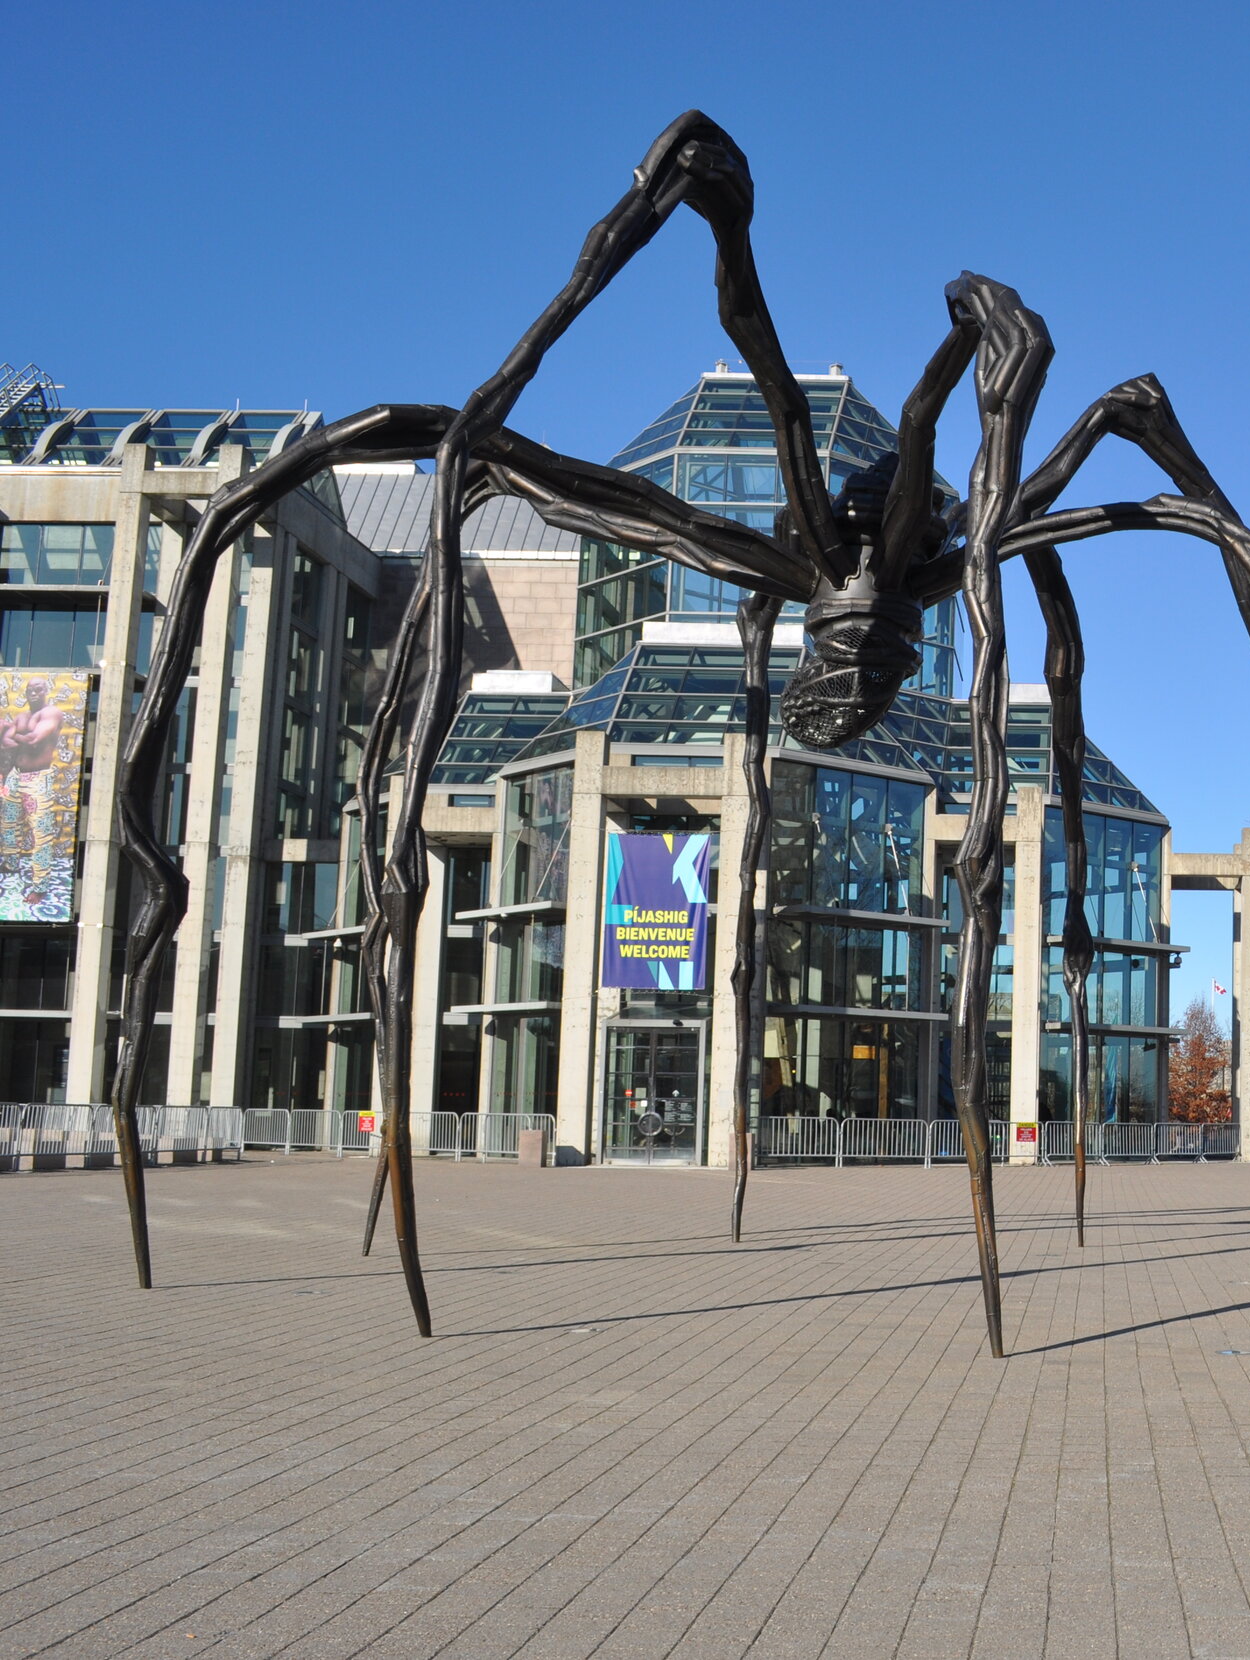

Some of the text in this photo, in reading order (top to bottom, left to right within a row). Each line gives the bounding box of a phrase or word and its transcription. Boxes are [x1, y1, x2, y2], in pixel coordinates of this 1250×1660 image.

[624, 906, 688, 923] PÍJASHIG
[616, 927, 694, 941] BIENVENUE
[619, 944, 690, 959] WELCOME
